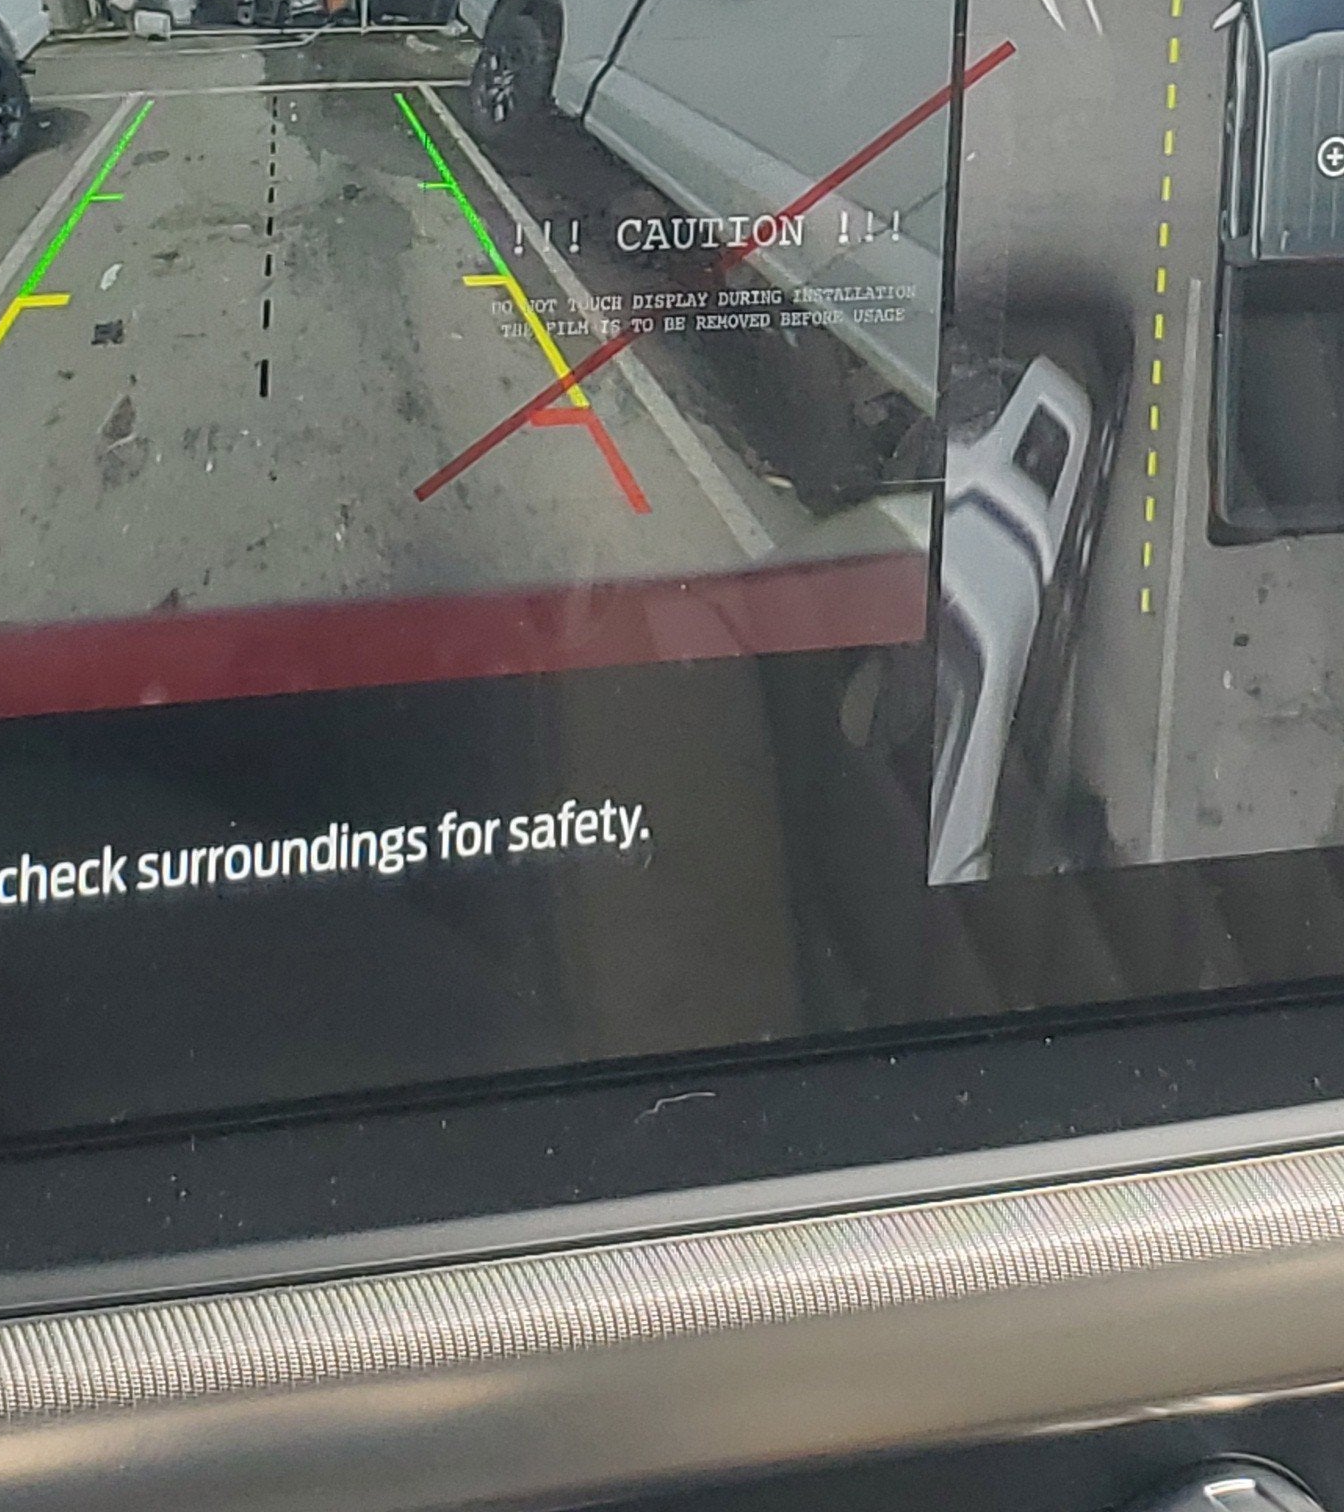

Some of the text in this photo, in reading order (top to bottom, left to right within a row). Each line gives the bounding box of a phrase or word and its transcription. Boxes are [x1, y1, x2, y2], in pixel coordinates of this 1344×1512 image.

[616, 213, 805, 253] CAUTION
[632, 291, 709, 311] DISPLAY
[717, 289, 783, 307] DURING
[601, 318, 621, 334] IS
[632, 316, 654, 333] TO
[664, 315, 686, 332] BE
[695, 313, 771, 331] REMOVED
[779, 309, 844, 327] BEFORE
[853, 307, 906, 325] USAGE
[136, 821, 428, 890] surroundings
[436, 809, 502, 862] for
[507, 797, 654, 855] safety.
